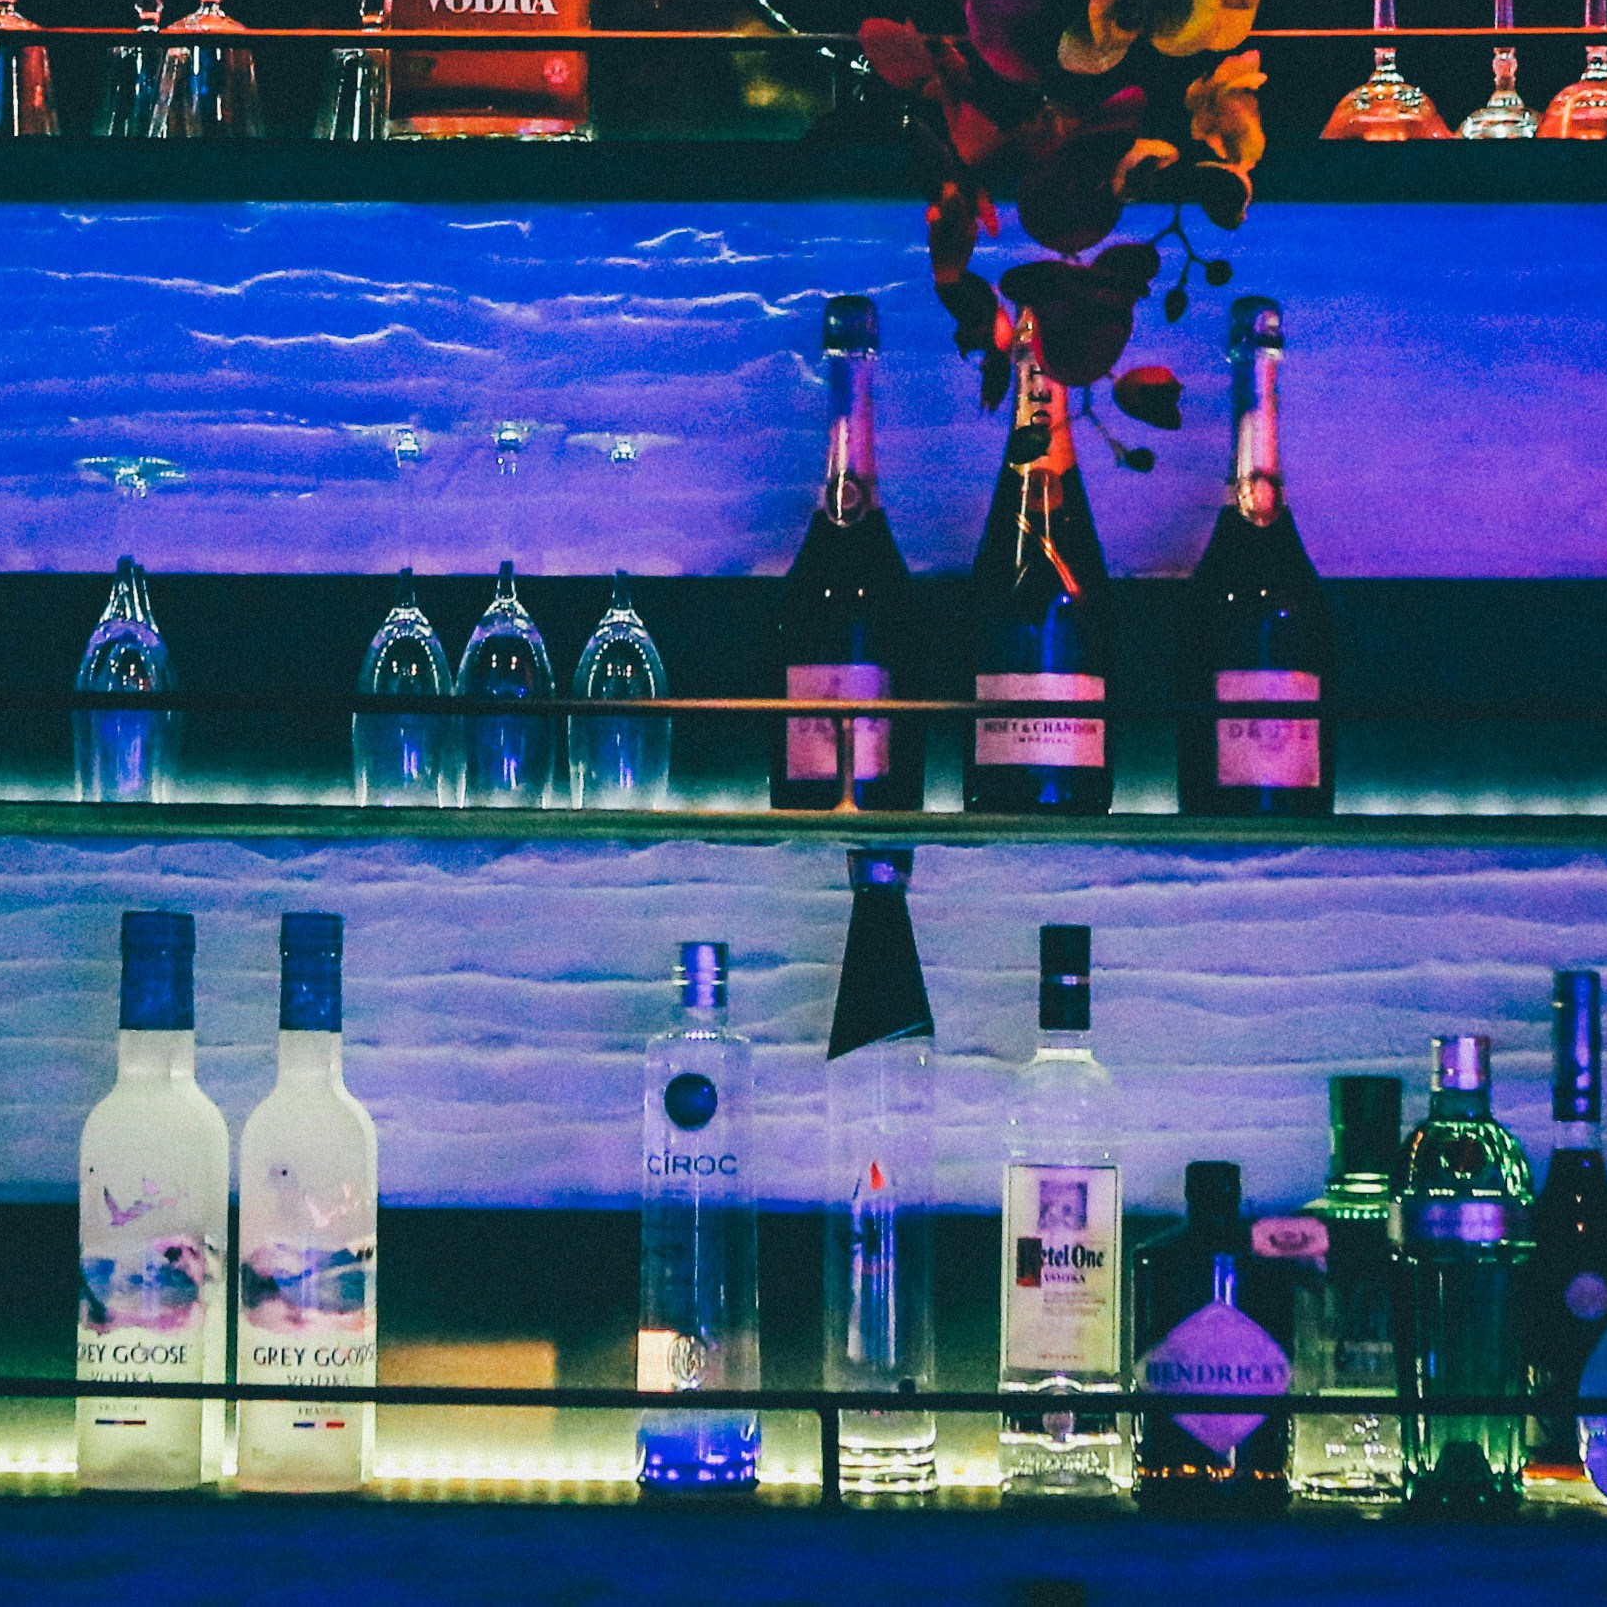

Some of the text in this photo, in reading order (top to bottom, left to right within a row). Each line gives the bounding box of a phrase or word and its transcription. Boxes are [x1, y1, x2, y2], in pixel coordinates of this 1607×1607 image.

[1071, 1243, 1105, 1269] One
[113, 1342, 187, 1364] GOOSE
[254, 1346, 305, 1366] GREY
